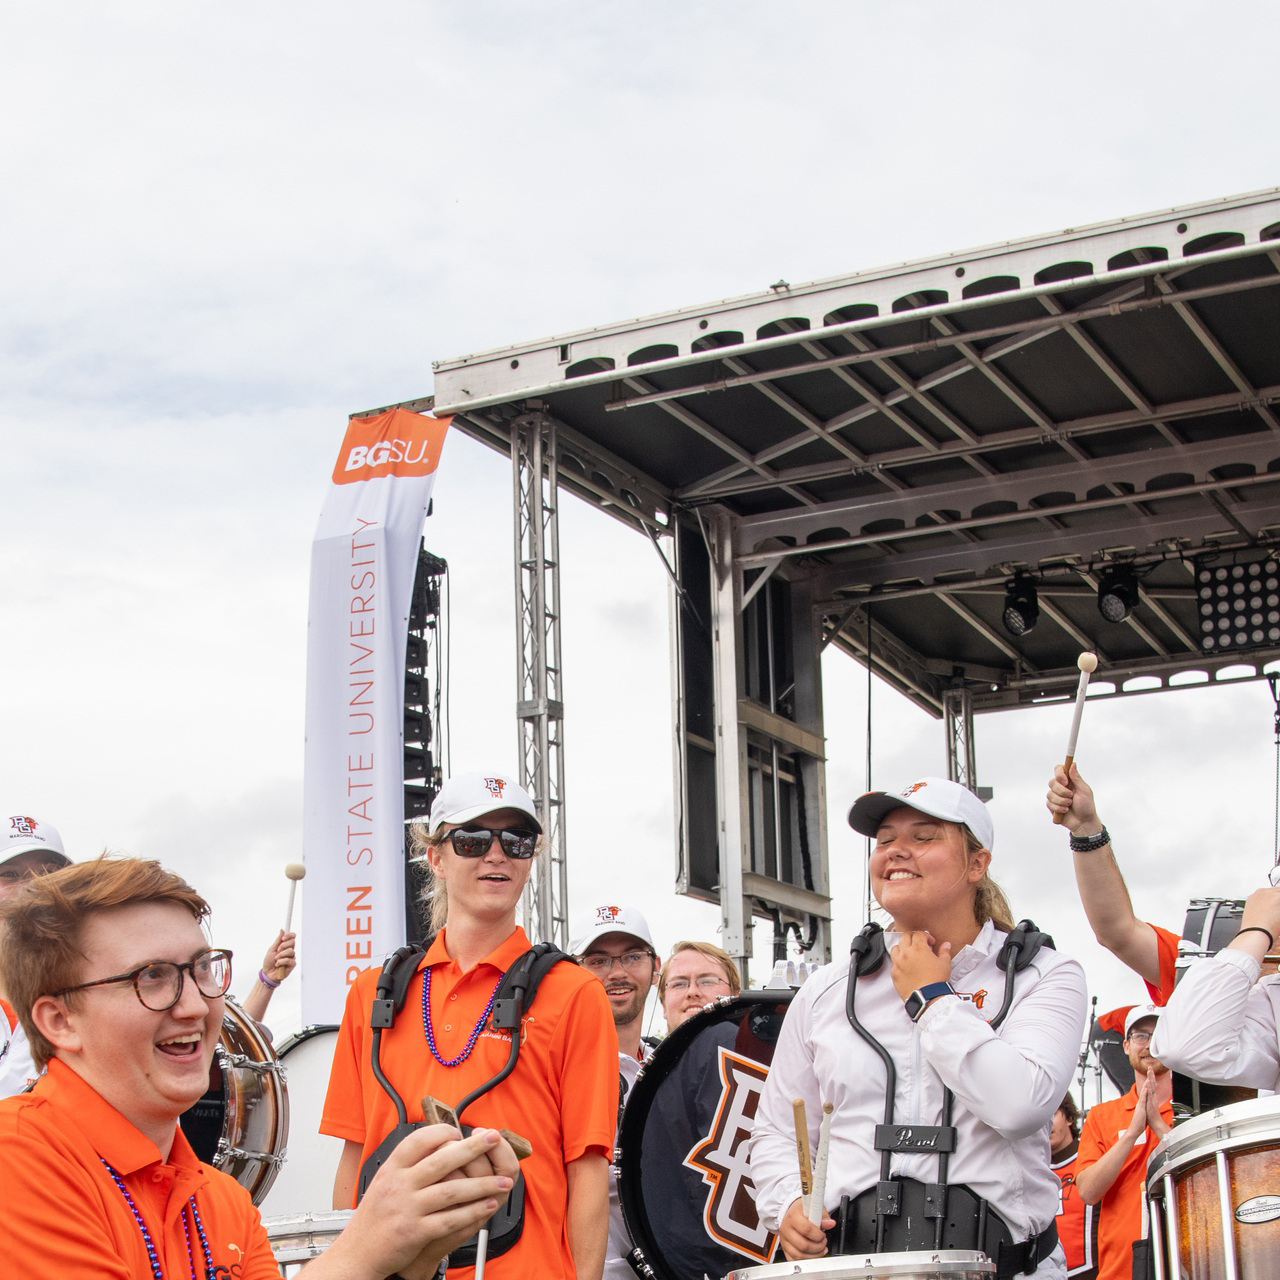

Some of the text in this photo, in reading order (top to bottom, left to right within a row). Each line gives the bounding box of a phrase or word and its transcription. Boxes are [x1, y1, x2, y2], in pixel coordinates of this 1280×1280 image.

[346, 518, 377, 985] REEN STATE UNIVERSITY
[889, 1127, 940, 1148] Pearl
